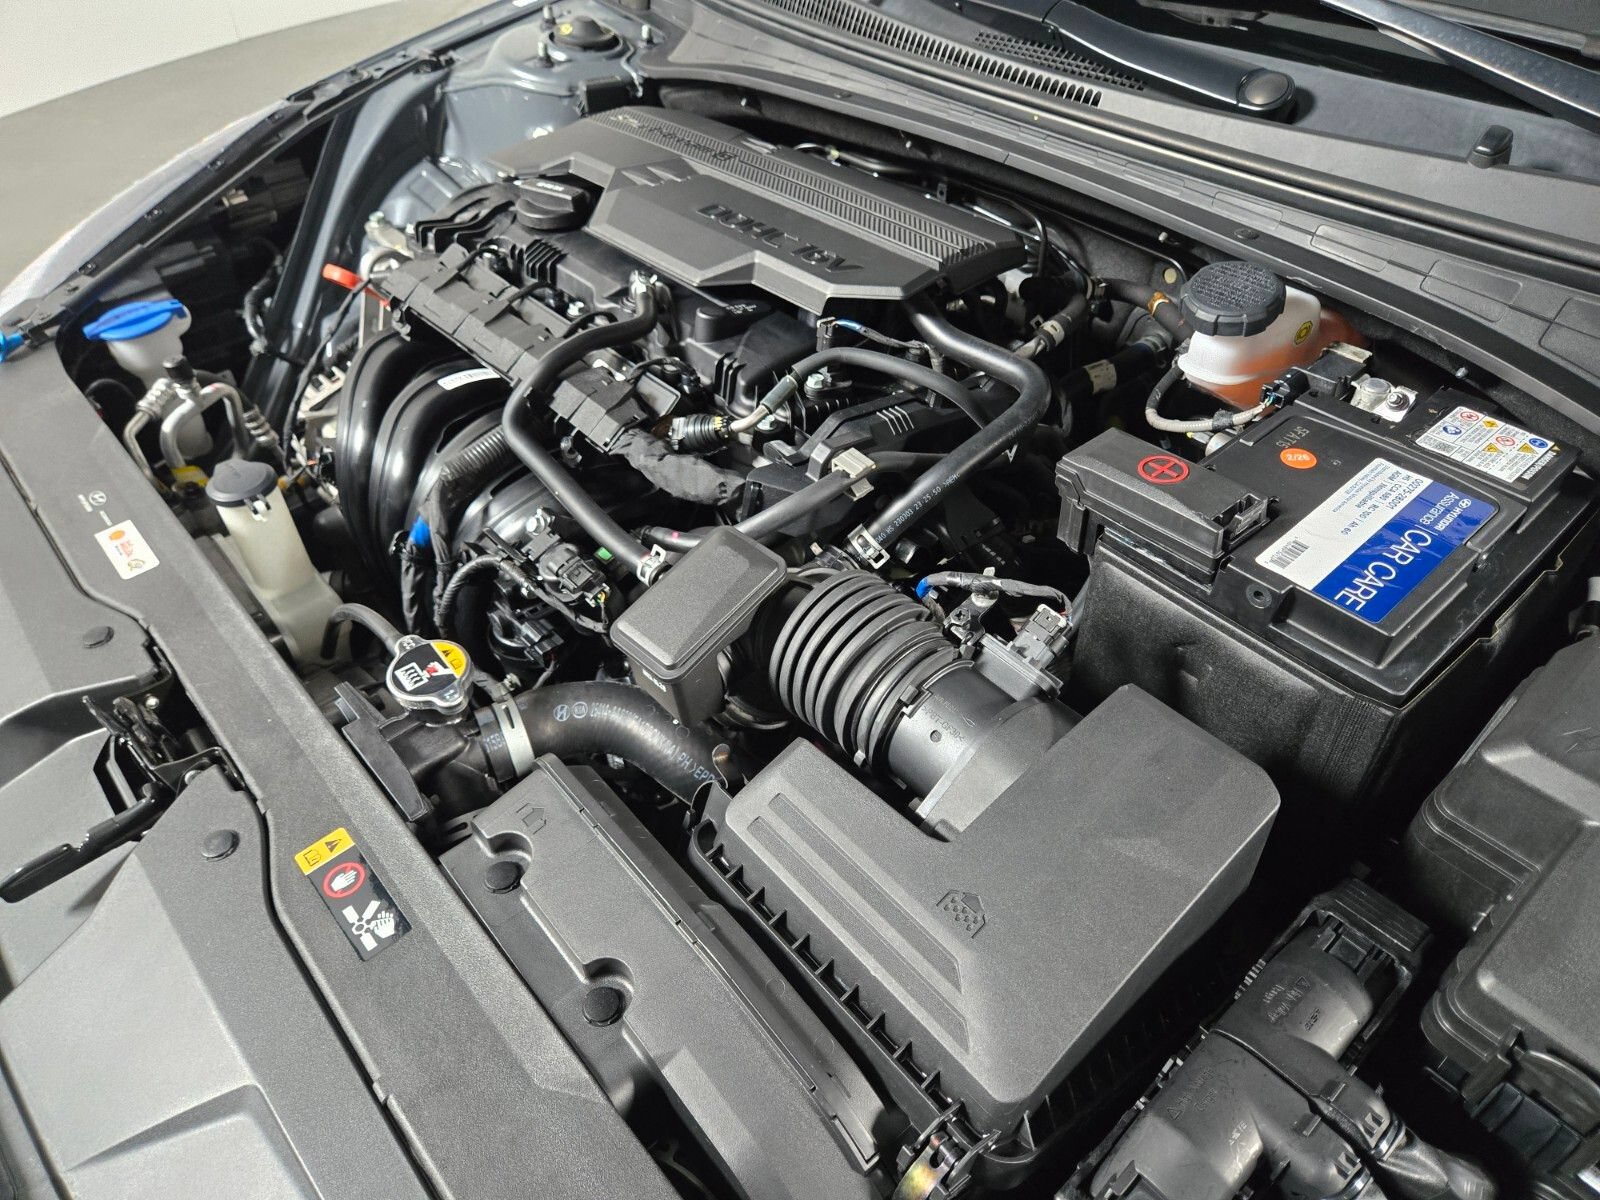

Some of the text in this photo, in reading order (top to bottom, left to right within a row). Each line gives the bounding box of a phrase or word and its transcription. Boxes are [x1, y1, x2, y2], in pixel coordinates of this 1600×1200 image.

[696, 204, 864, 272] DOHC 16V
[1386, 478, 1424, 510] 00275-28001
[1418, 491, 1462, 526] Assurance
[1433, 505, 1464, 531] HYUNDAI
[1333, 526, 1435, 611] CAR CARE
